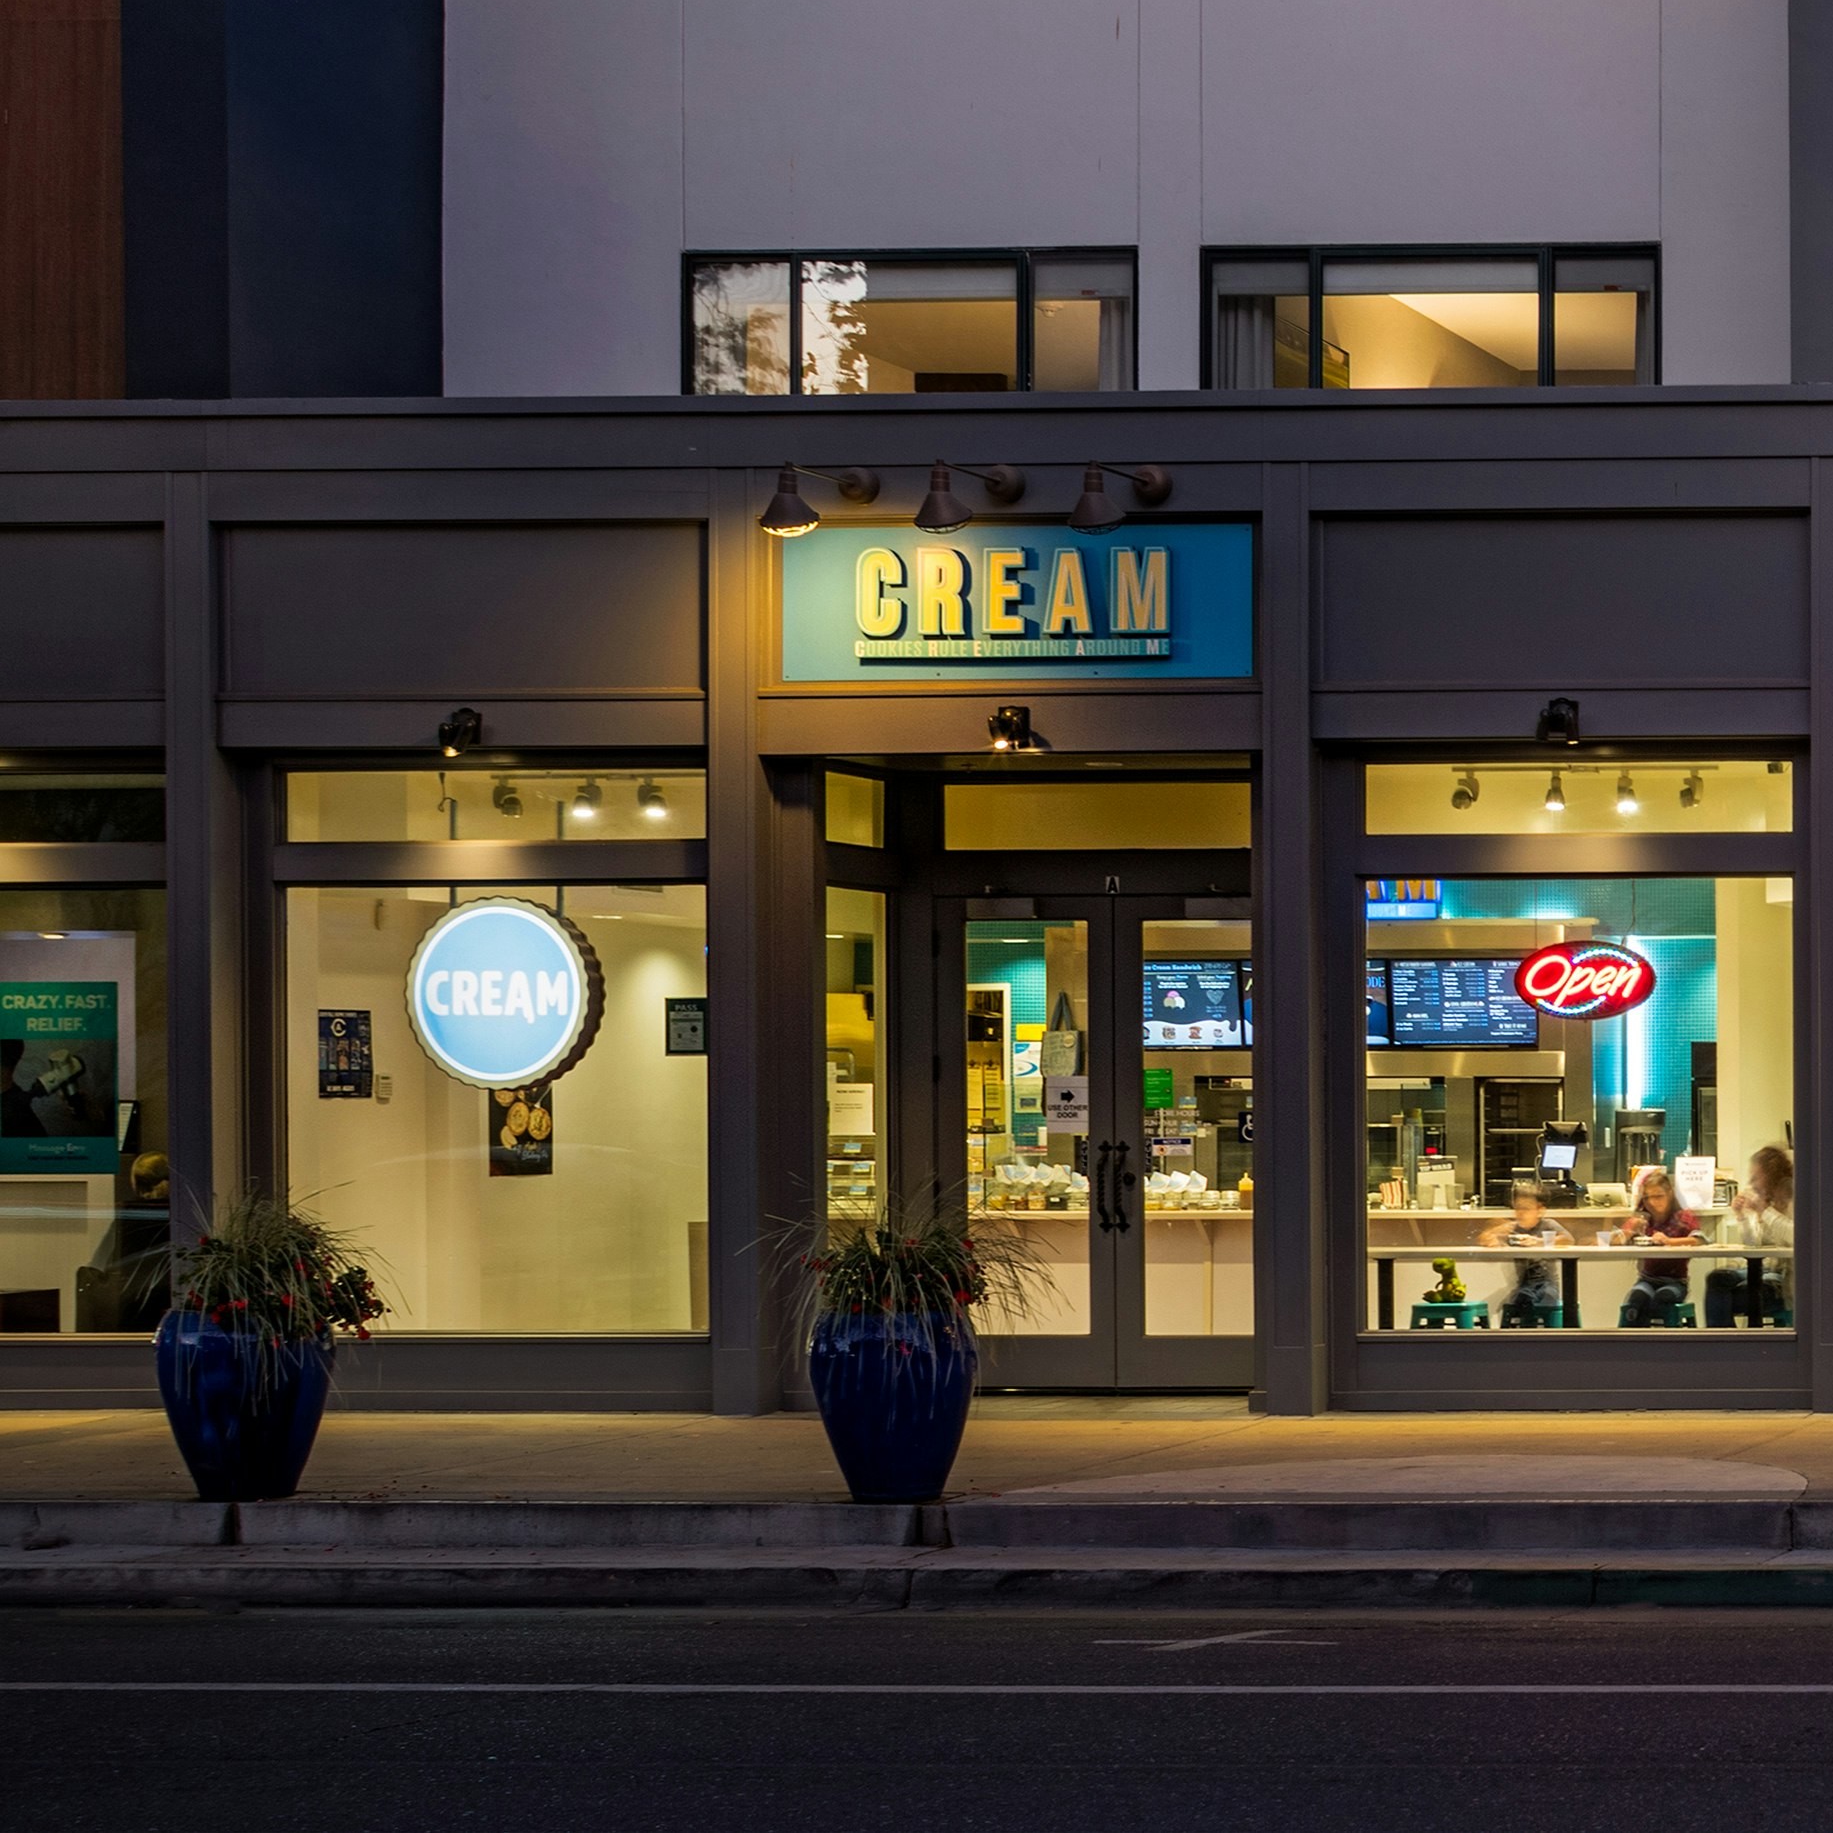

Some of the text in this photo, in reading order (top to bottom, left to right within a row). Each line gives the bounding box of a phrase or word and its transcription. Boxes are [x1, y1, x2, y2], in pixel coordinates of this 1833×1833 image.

[855, 546, 1171, 634] CREAM
[854, 639, 1170, 657] COOKIES RULE EVERYTHING AROUND ME
[1107, 876, 1118, 893] A
[1525, 955, 1642, 1007] Open
[2, 995, 111, 1009] CRAZY. FAST.
[425, 970, 568, 1024] CREAM
[26, 1017, 87, 1031] RELIEF.
